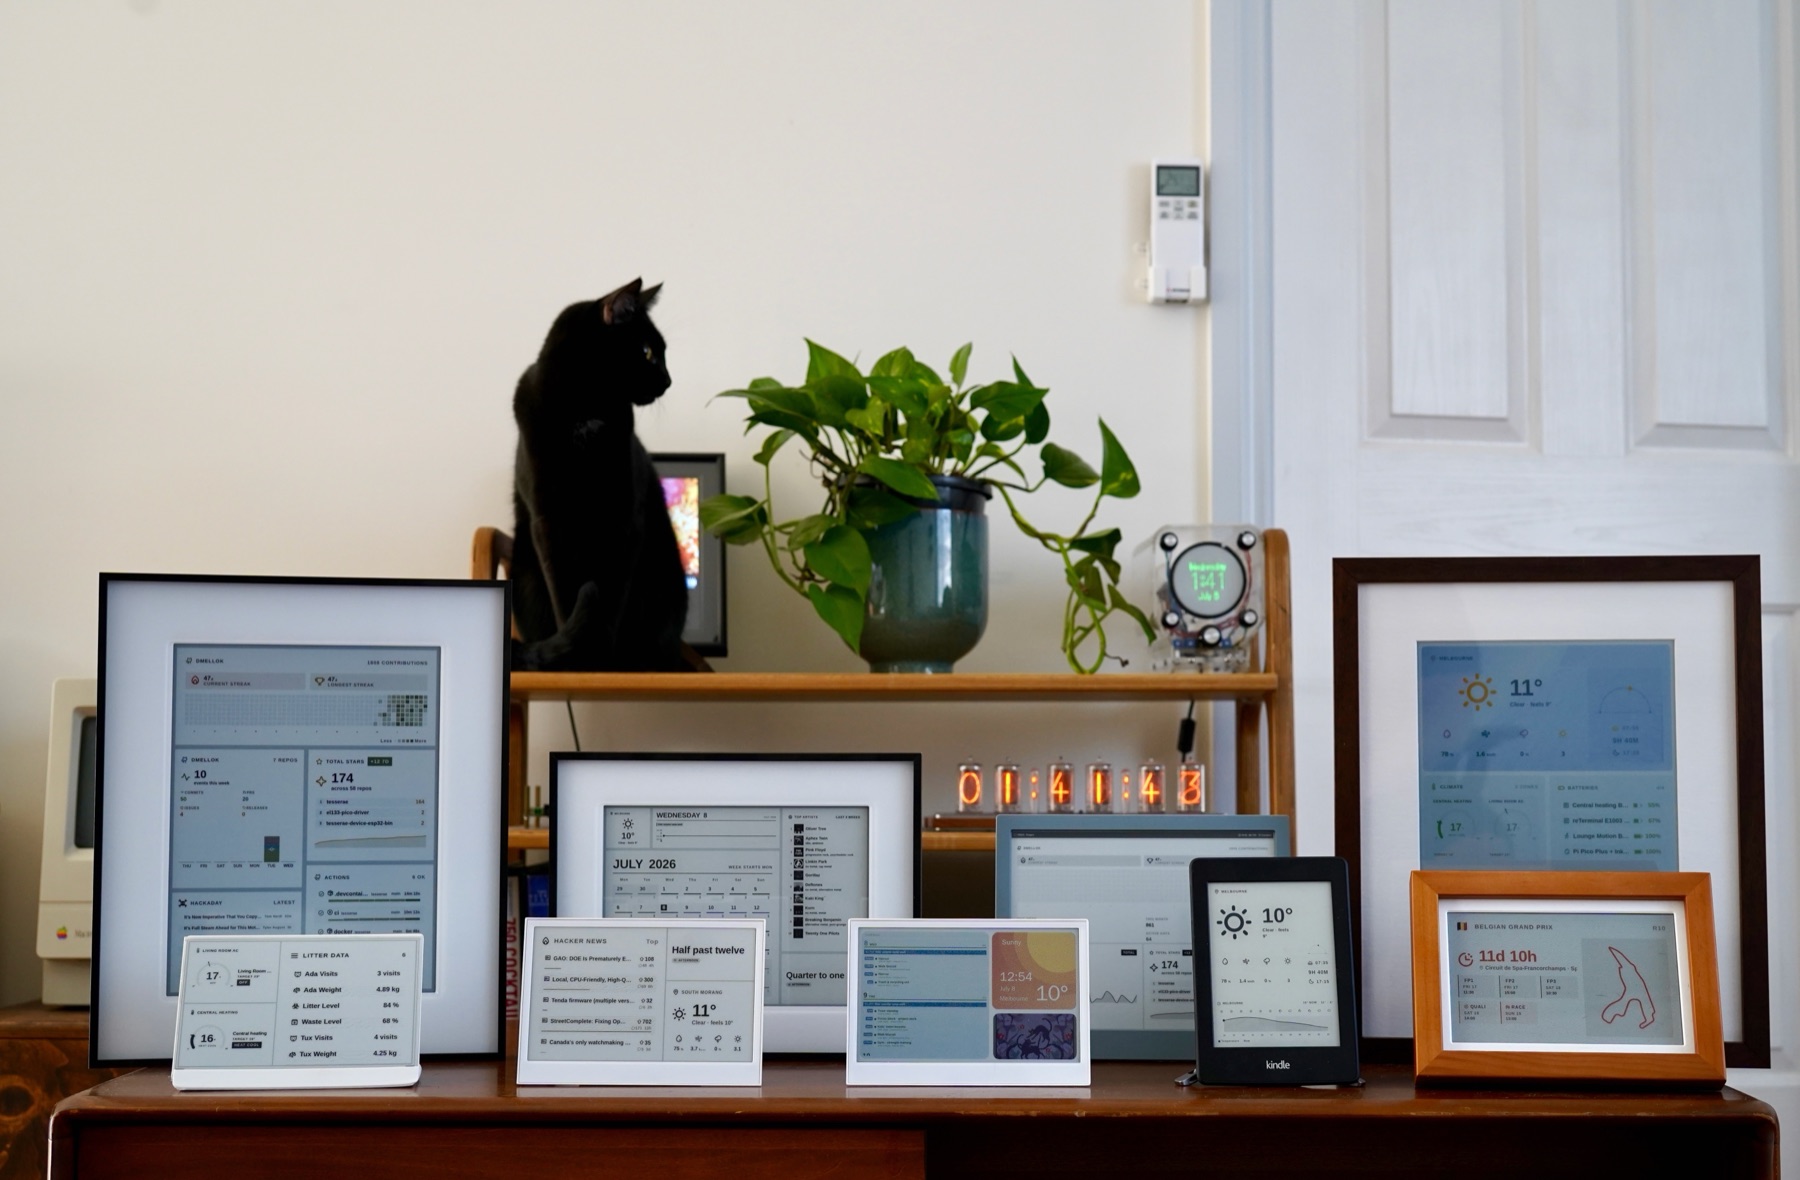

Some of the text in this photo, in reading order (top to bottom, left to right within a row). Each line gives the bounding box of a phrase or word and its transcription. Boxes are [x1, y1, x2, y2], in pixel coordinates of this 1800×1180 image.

[1510, 679, 1543, 696] 11°
[194, 770, 207, 779] 10
[331, 773, 354, 784] 174
[621, 832, 635, 840] 10°
[613, 859, 676, 869] JULY 2026
[1262, 908, 1293, 923] 10°
[1001, 939, 1021, 947] Sunny
[672, 945, 745, 957] Half past twelve
[1479, 950, 1537, 963] 11d 10h
[1162, 961, 1178, 969] 174
[786, 971, 845, 980] Quarter to one
[1000, 972, 1032, 982] 12:54
[1036, 985, 1068, 1001] 10°
[692, 1004, 716, 1017] 11°
[1266, 1060, 1290, 1069] kindle
